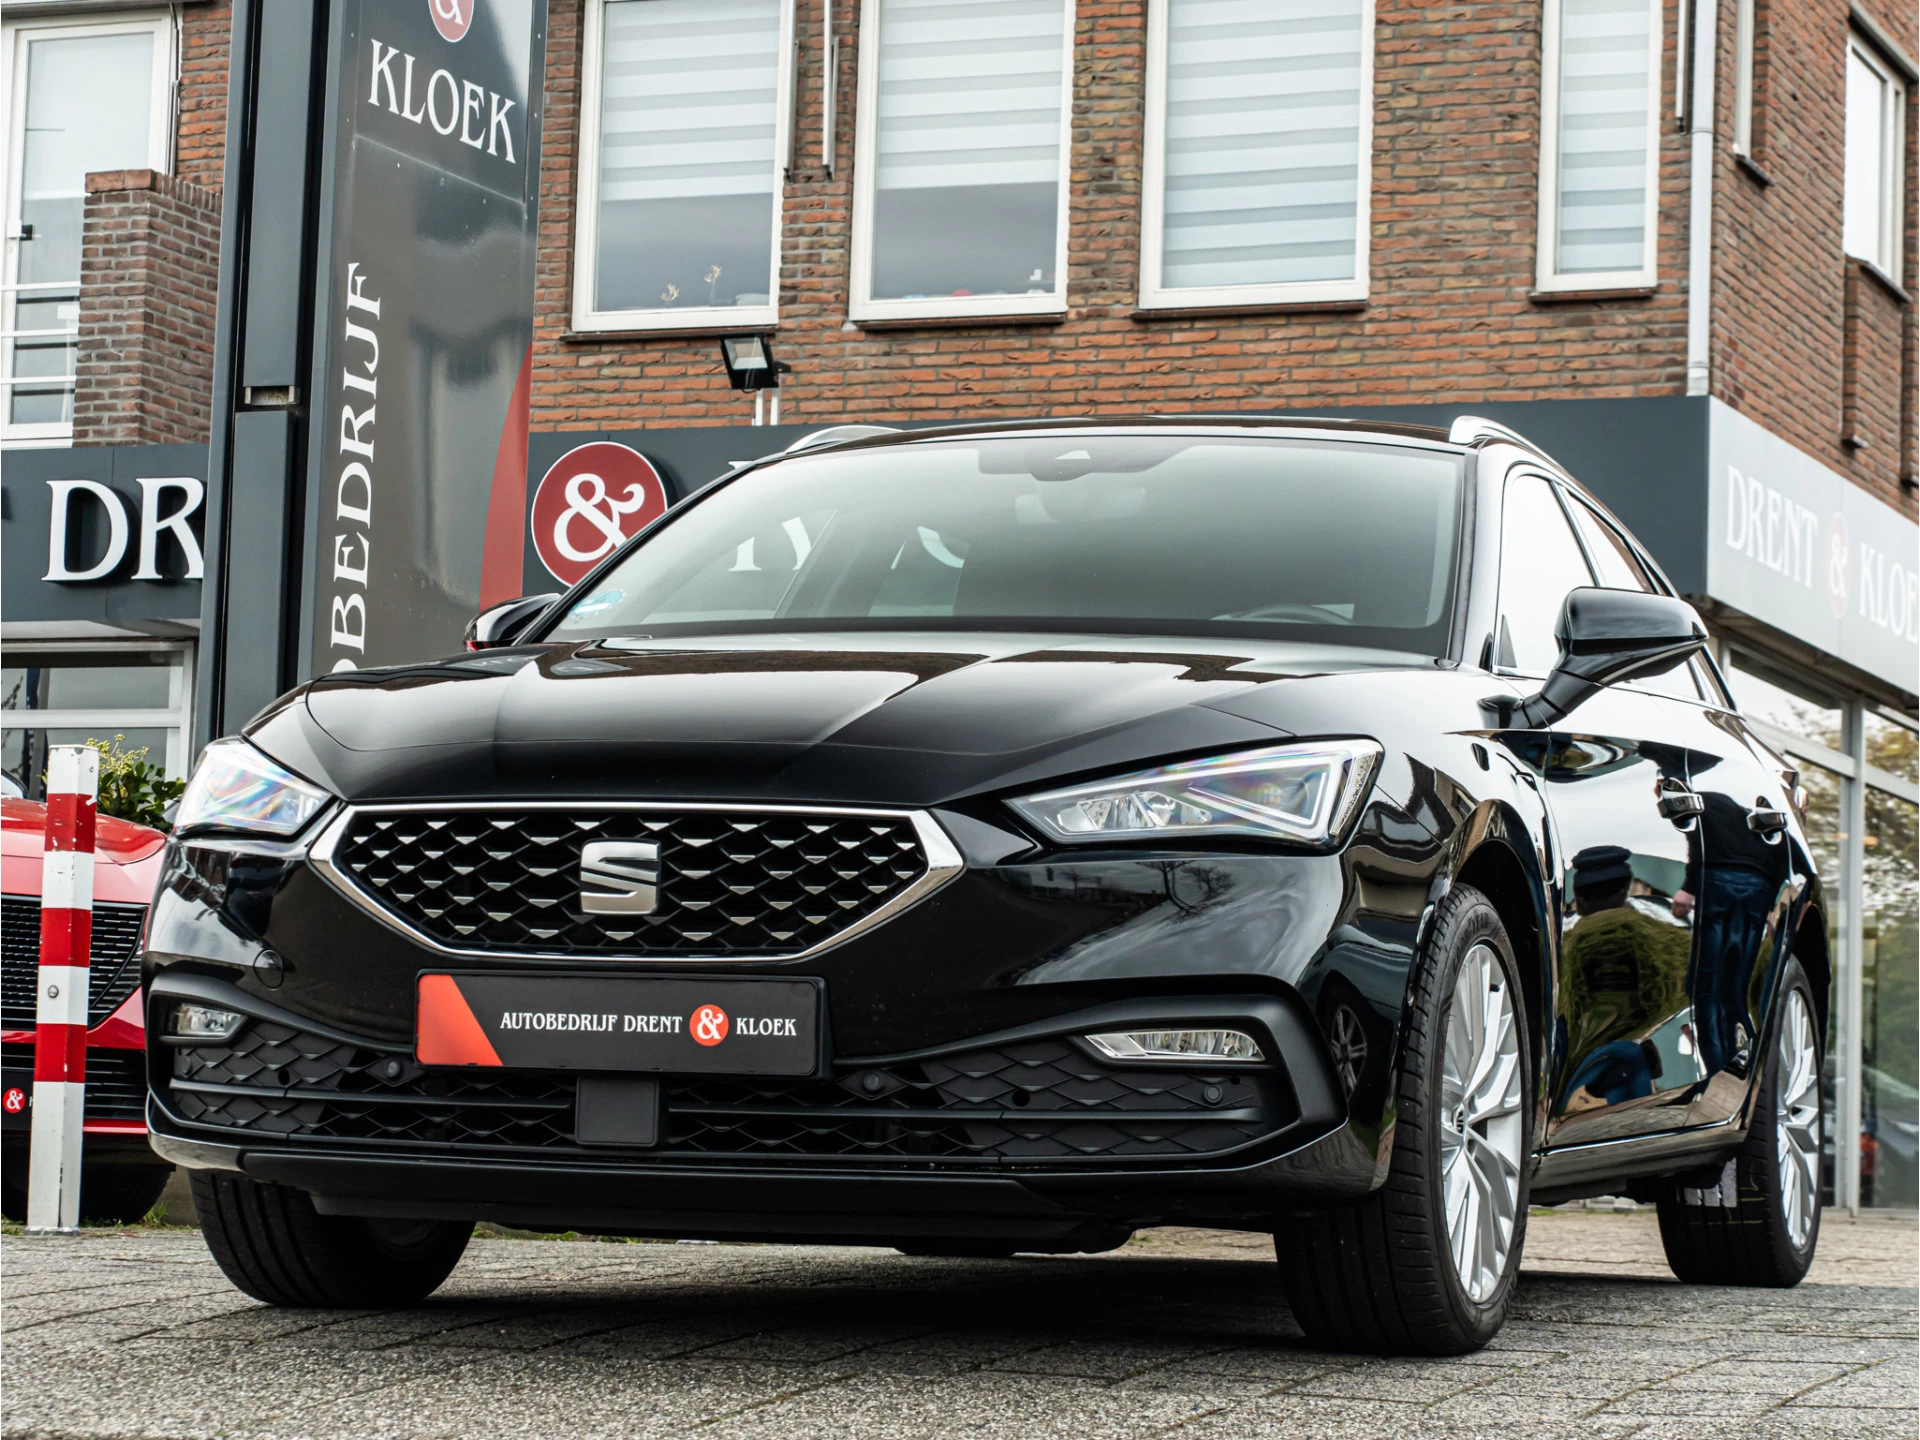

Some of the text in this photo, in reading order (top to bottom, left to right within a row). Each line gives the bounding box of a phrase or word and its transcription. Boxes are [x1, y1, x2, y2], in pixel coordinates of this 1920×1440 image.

[368, 38, 516, 164] KLOEK
[330, 262, 381, 675] BEDRIJF
[41, 477, 205, 581] DR
[1725, 464, 1919, 646] DRENT & KLOE
[500, 1008, 798, 1040] AUTOBEDRIJF DRENT & KLOEK
[6, 1090, 24, 1110] &
